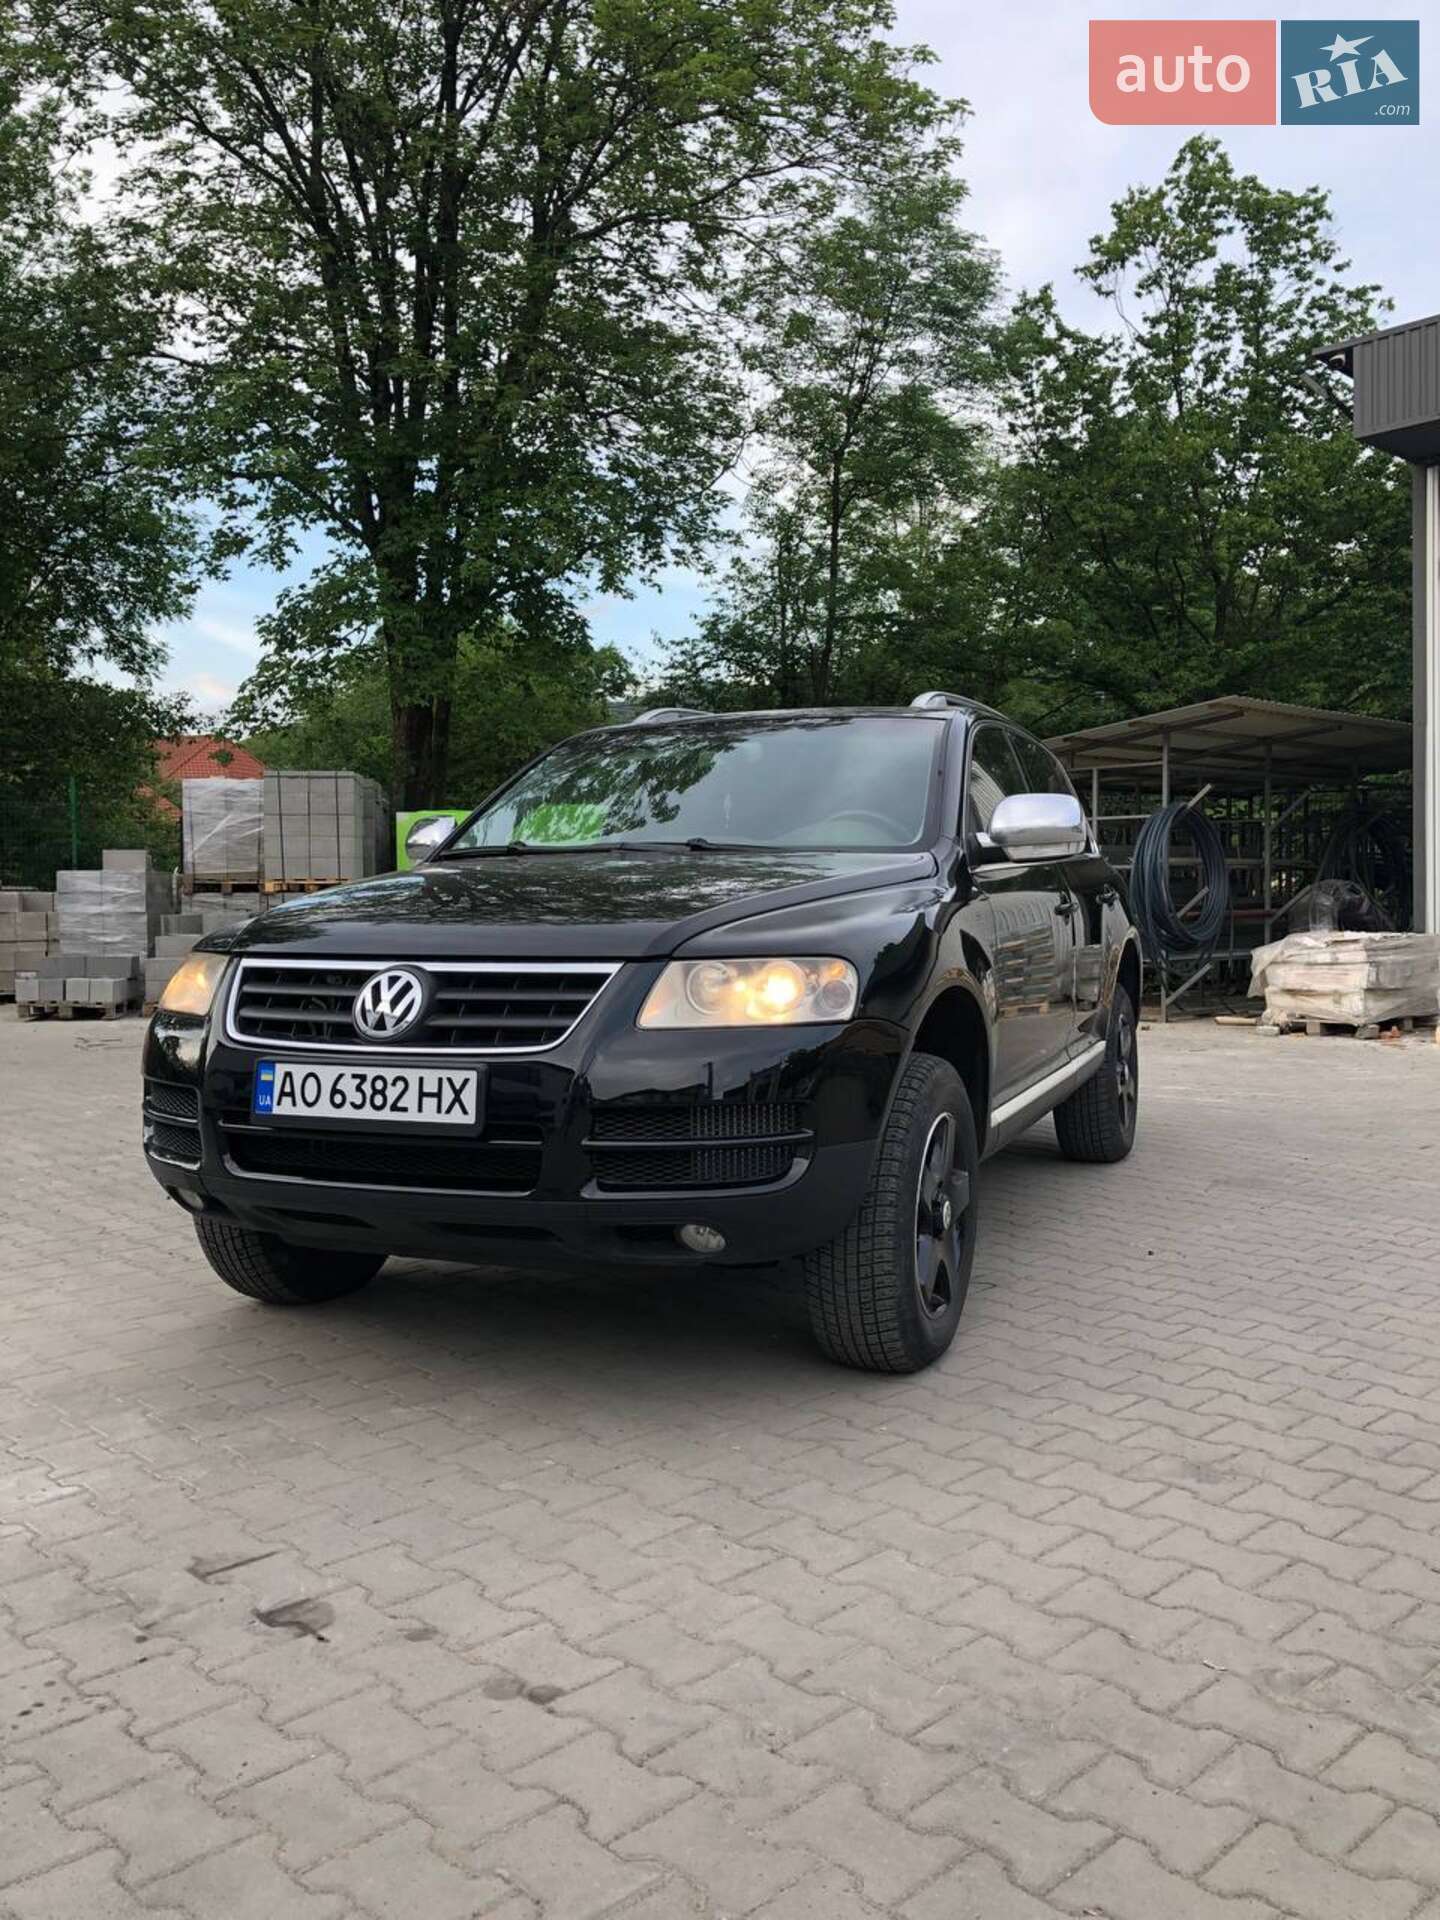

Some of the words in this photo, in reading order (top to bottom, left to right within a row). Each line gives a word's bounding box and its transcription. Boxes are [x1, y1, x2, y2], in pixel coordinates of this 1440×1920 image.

[259, 1096, 271, 1106] UA
[276, 1071, 322, 1107] AO
[329, 1072, 410, 1113] 6382
[417, 1077, 470, 1115] HX
